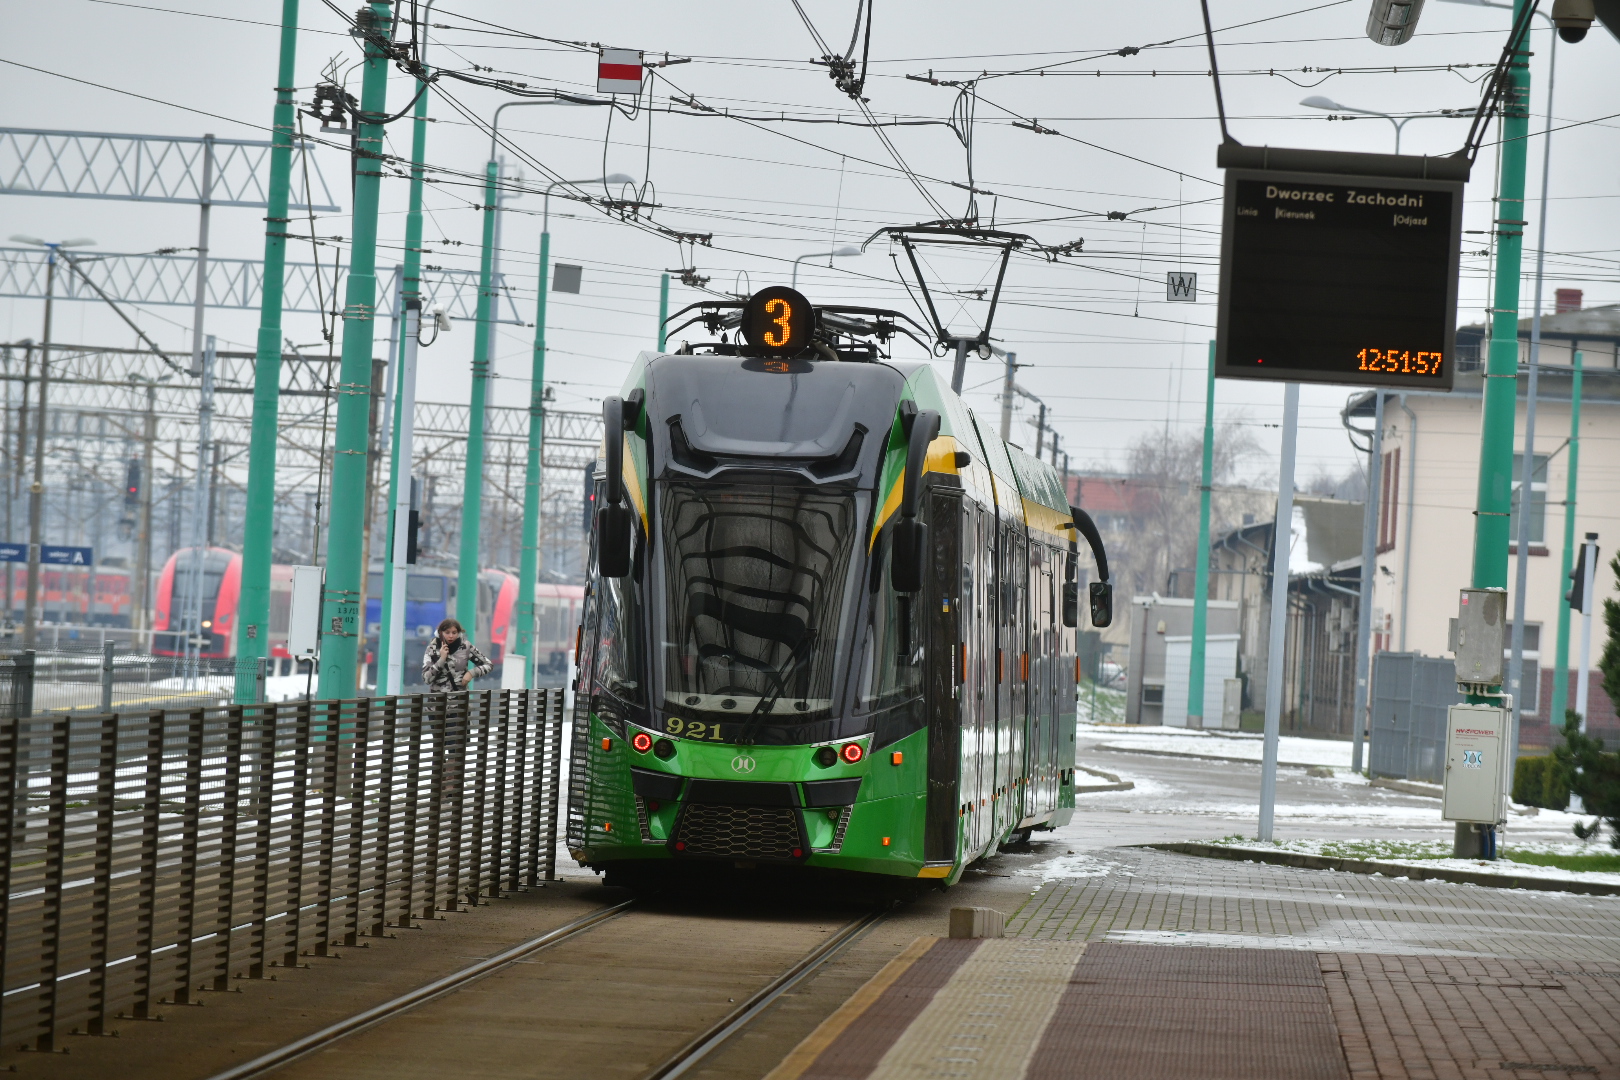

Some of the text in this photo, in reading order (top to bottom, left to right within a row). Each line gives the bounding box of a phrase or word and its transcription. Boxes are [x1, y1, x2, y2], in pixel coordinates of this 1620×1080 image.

[1266, 185, 1423, 208] Dworzec Zachodni
[1237, 207, 1258, 216] Linia
[1278, 207, 1315, 220] Kierunek
[1396, 215, 1427, 227] Odjazd
[1171, 276, 1192, 297] W
[764, 298, 791, 347] 3
[1356, 348, 1442, 375] 12:51:57
[72, 551, 84, 564] A
[666, 717, 724, 741] 921
